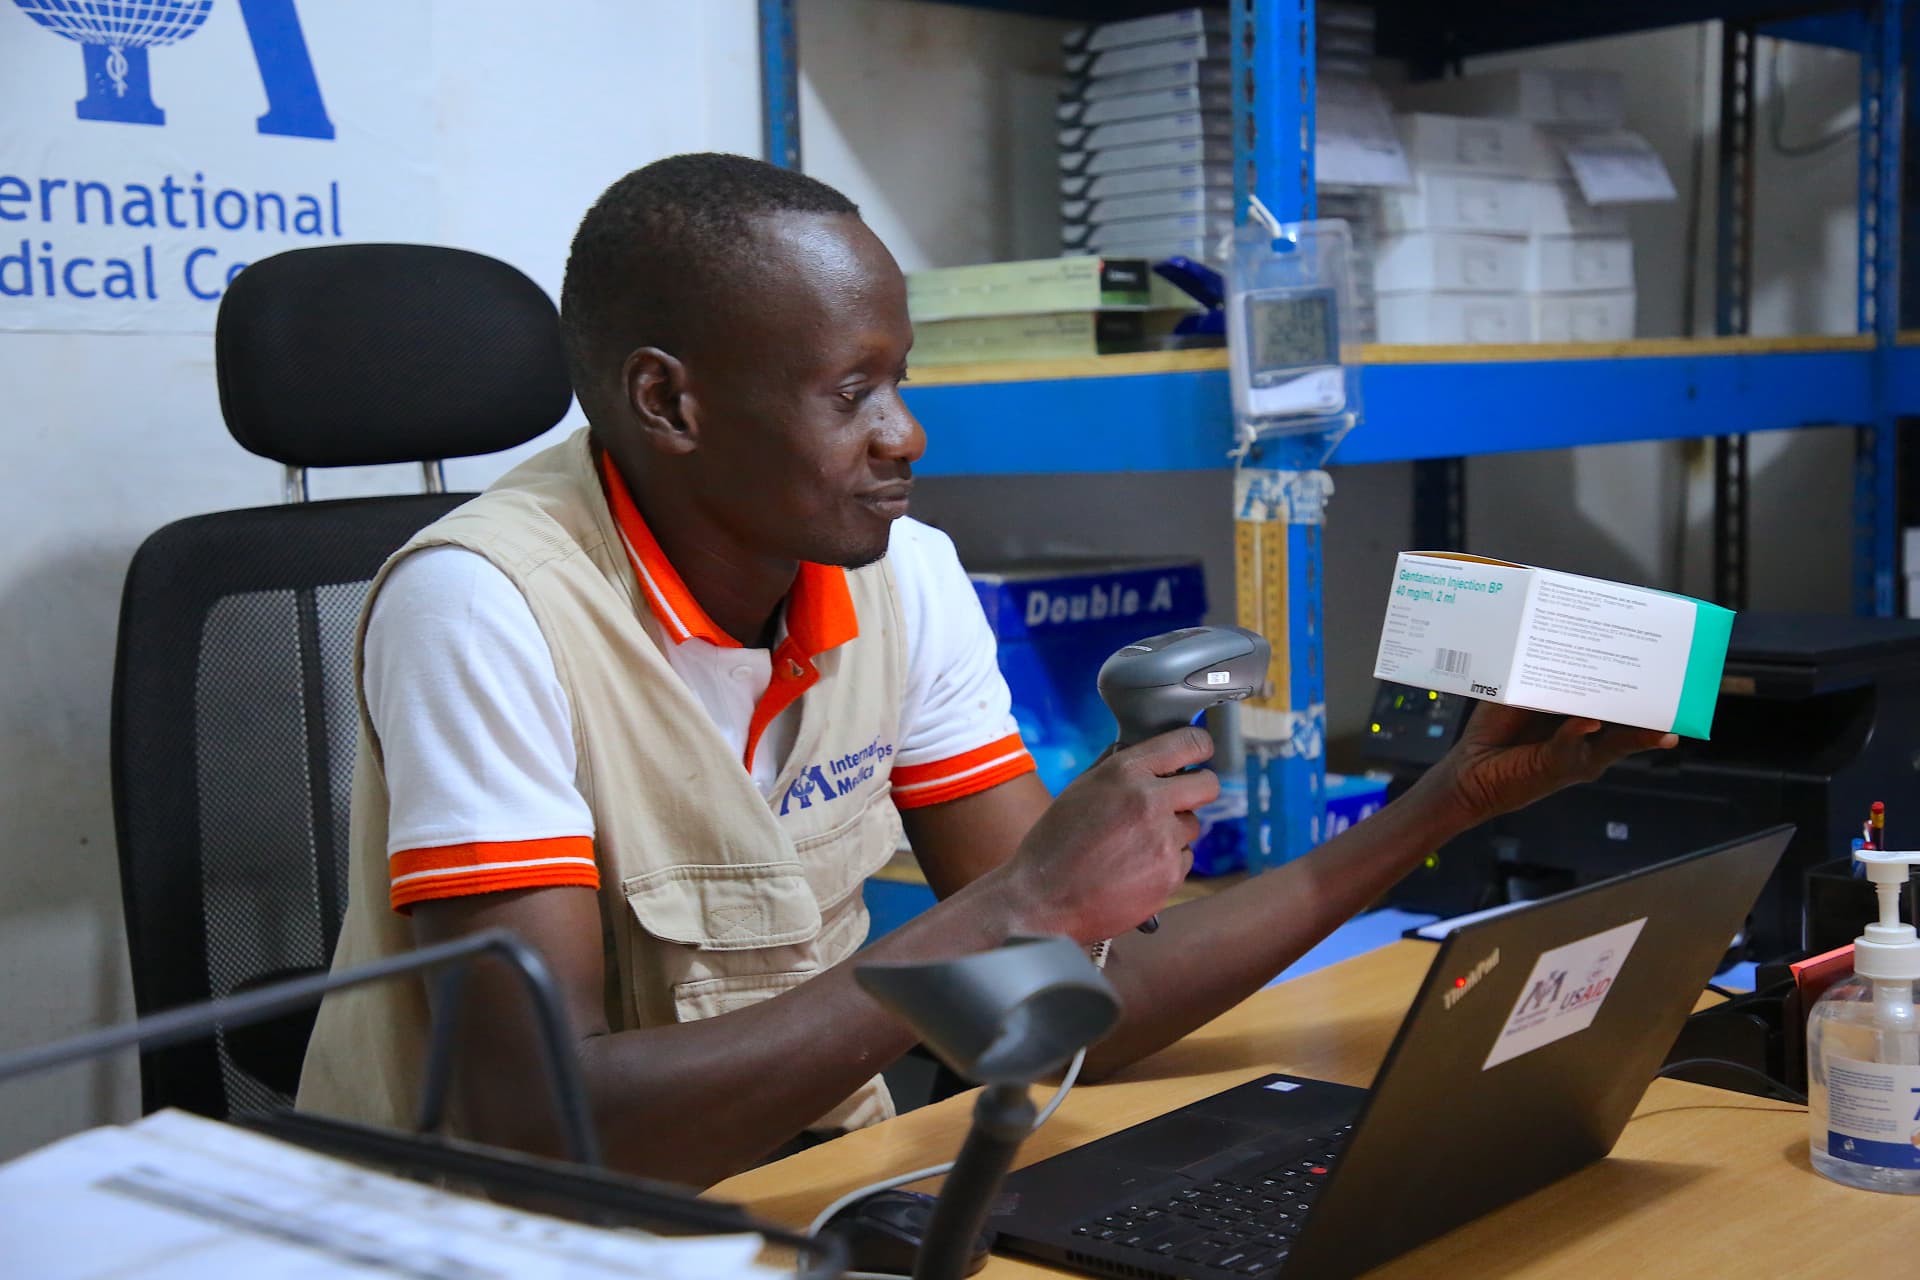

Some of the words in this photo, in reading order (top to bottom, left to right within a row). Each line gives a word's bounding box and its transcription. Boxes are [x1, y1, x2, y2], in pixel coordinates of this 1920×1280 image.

[0, 171, 343, 237] ernational
[0, 238, 158, 300] dical
[1396, 585, 1406, 596] 40
[1436, 591, 1443, 602] 2
[1444, 592, 1456, 604] ml
[1399, 569, 1446, 586] Gentamicin
[1448, 576, 1486, 592] Injection
[1488, 581, 1503, 594] BP
[1025, 582, 1140, 627] Double
[1148, 577, 1173, 613] A
[1470, 680, 1498, 697] imres
[1560, 977, 1611, 1010] USAID
